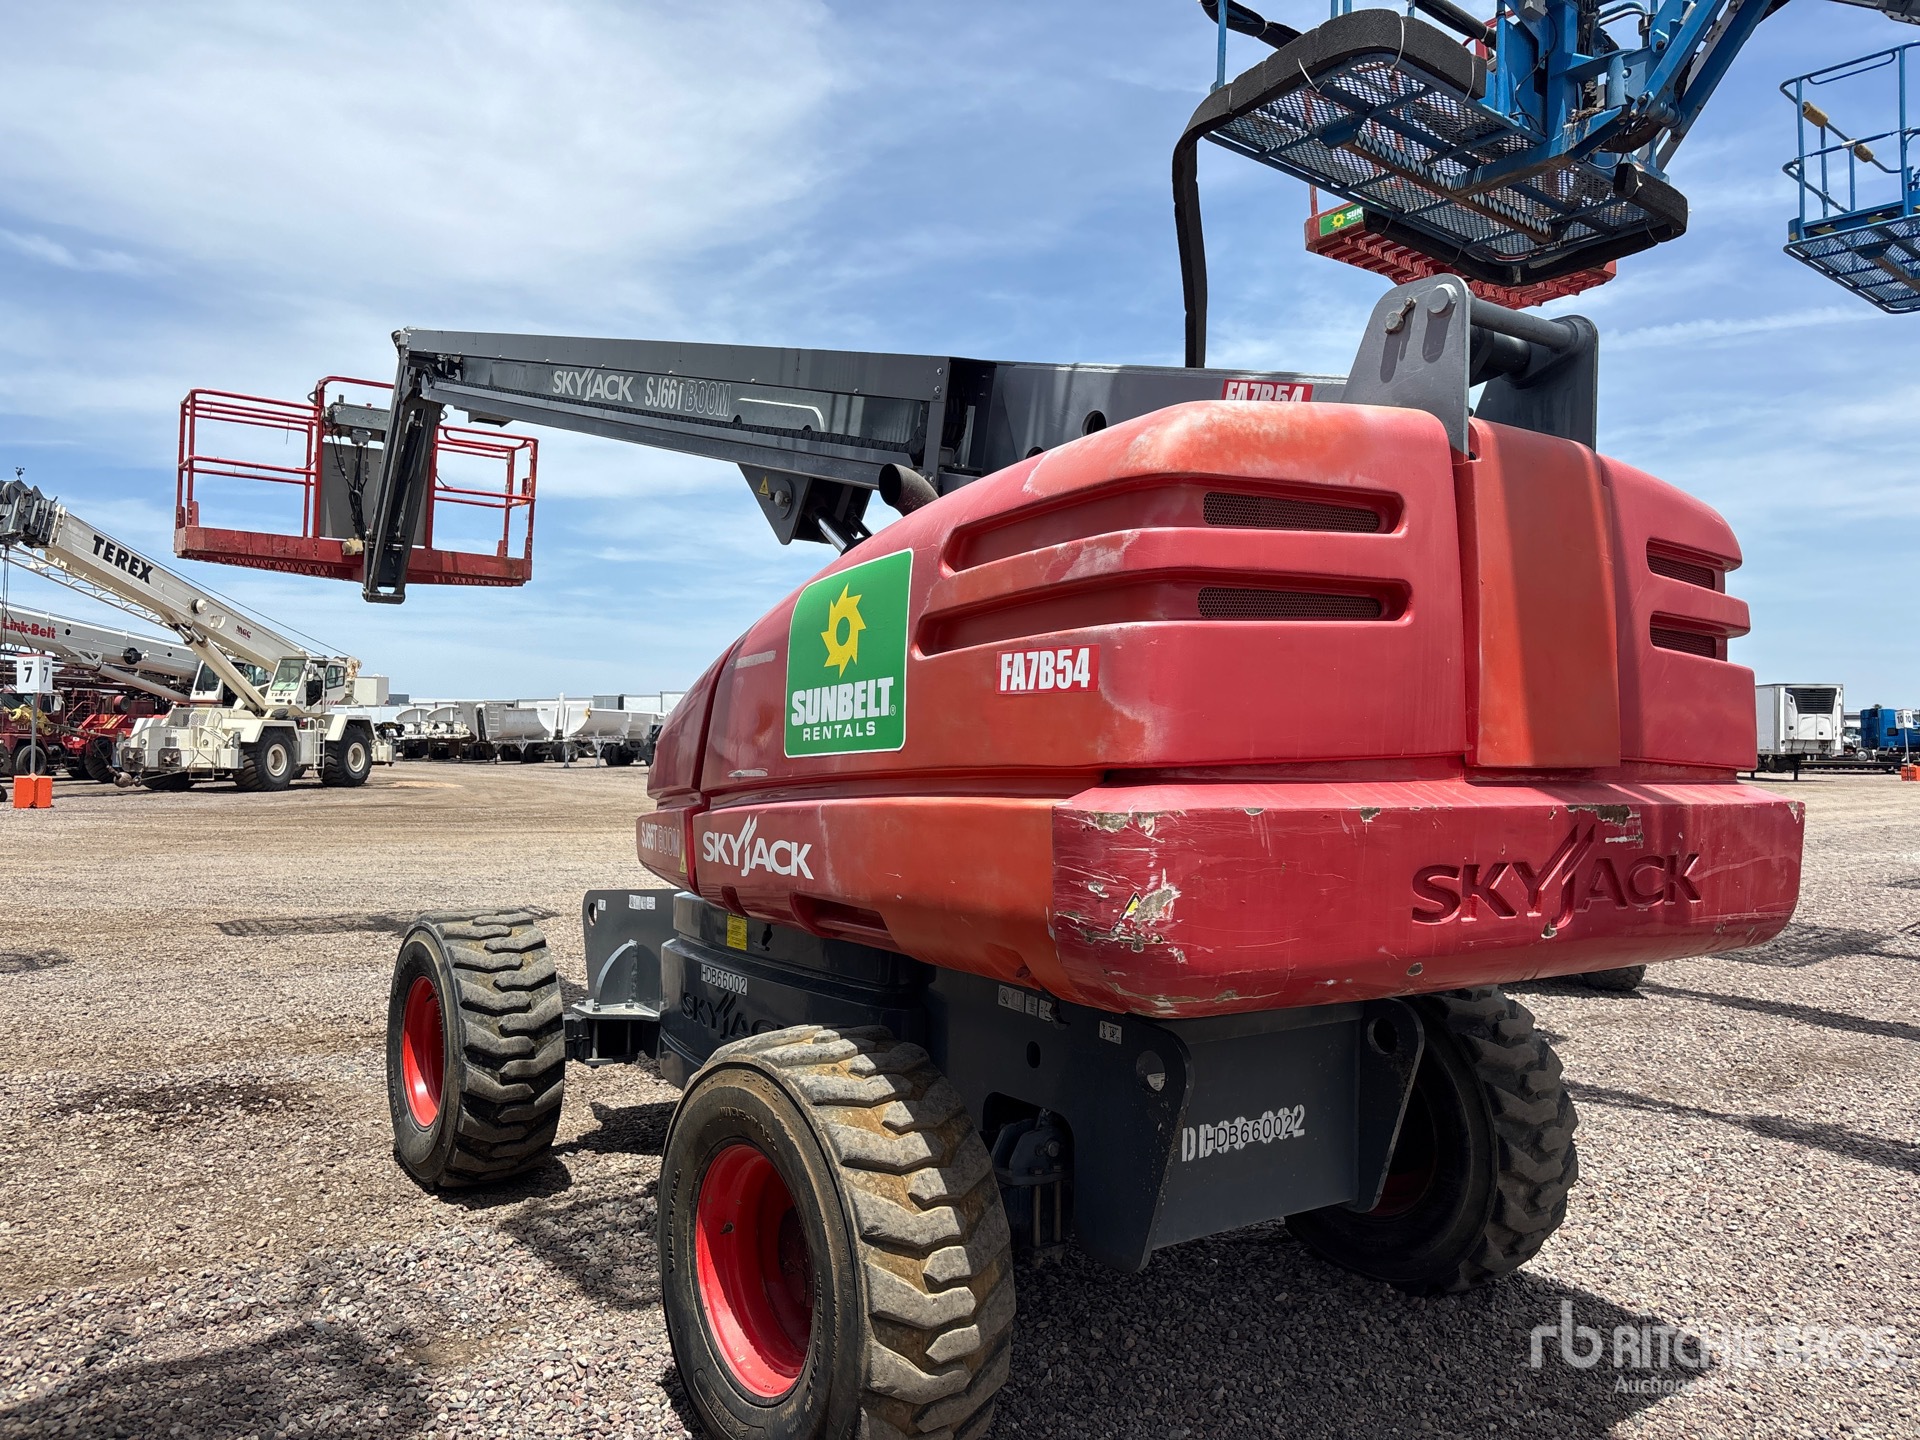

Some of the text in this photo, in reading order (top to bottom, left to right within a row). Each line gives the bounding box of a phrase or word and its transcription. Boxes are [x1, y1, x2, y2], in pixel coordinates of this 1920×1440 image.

[553, 368, 633, 402] SKYJACK
[685, 380, 731, 416] BOOM
[93, 534, 154, 584] TEREX
[24, 667, 33, 683] 7
[43, 667, 49, 683] 7
[1000, 648, 1090, 691] FA7B54
[791, 676, 894, 726] SUNBELT
[803, 721, 876, 741] RENTALS
[702, 814, 815, 880] SKYJACK
[1411, 824, 1701, 930] SKYJACK
[701, 965, 747, 995] HDB66002
[682, 991, 786, 1040] SKYJAC
[1205, 1114, 1294, 1150] HDB66002
